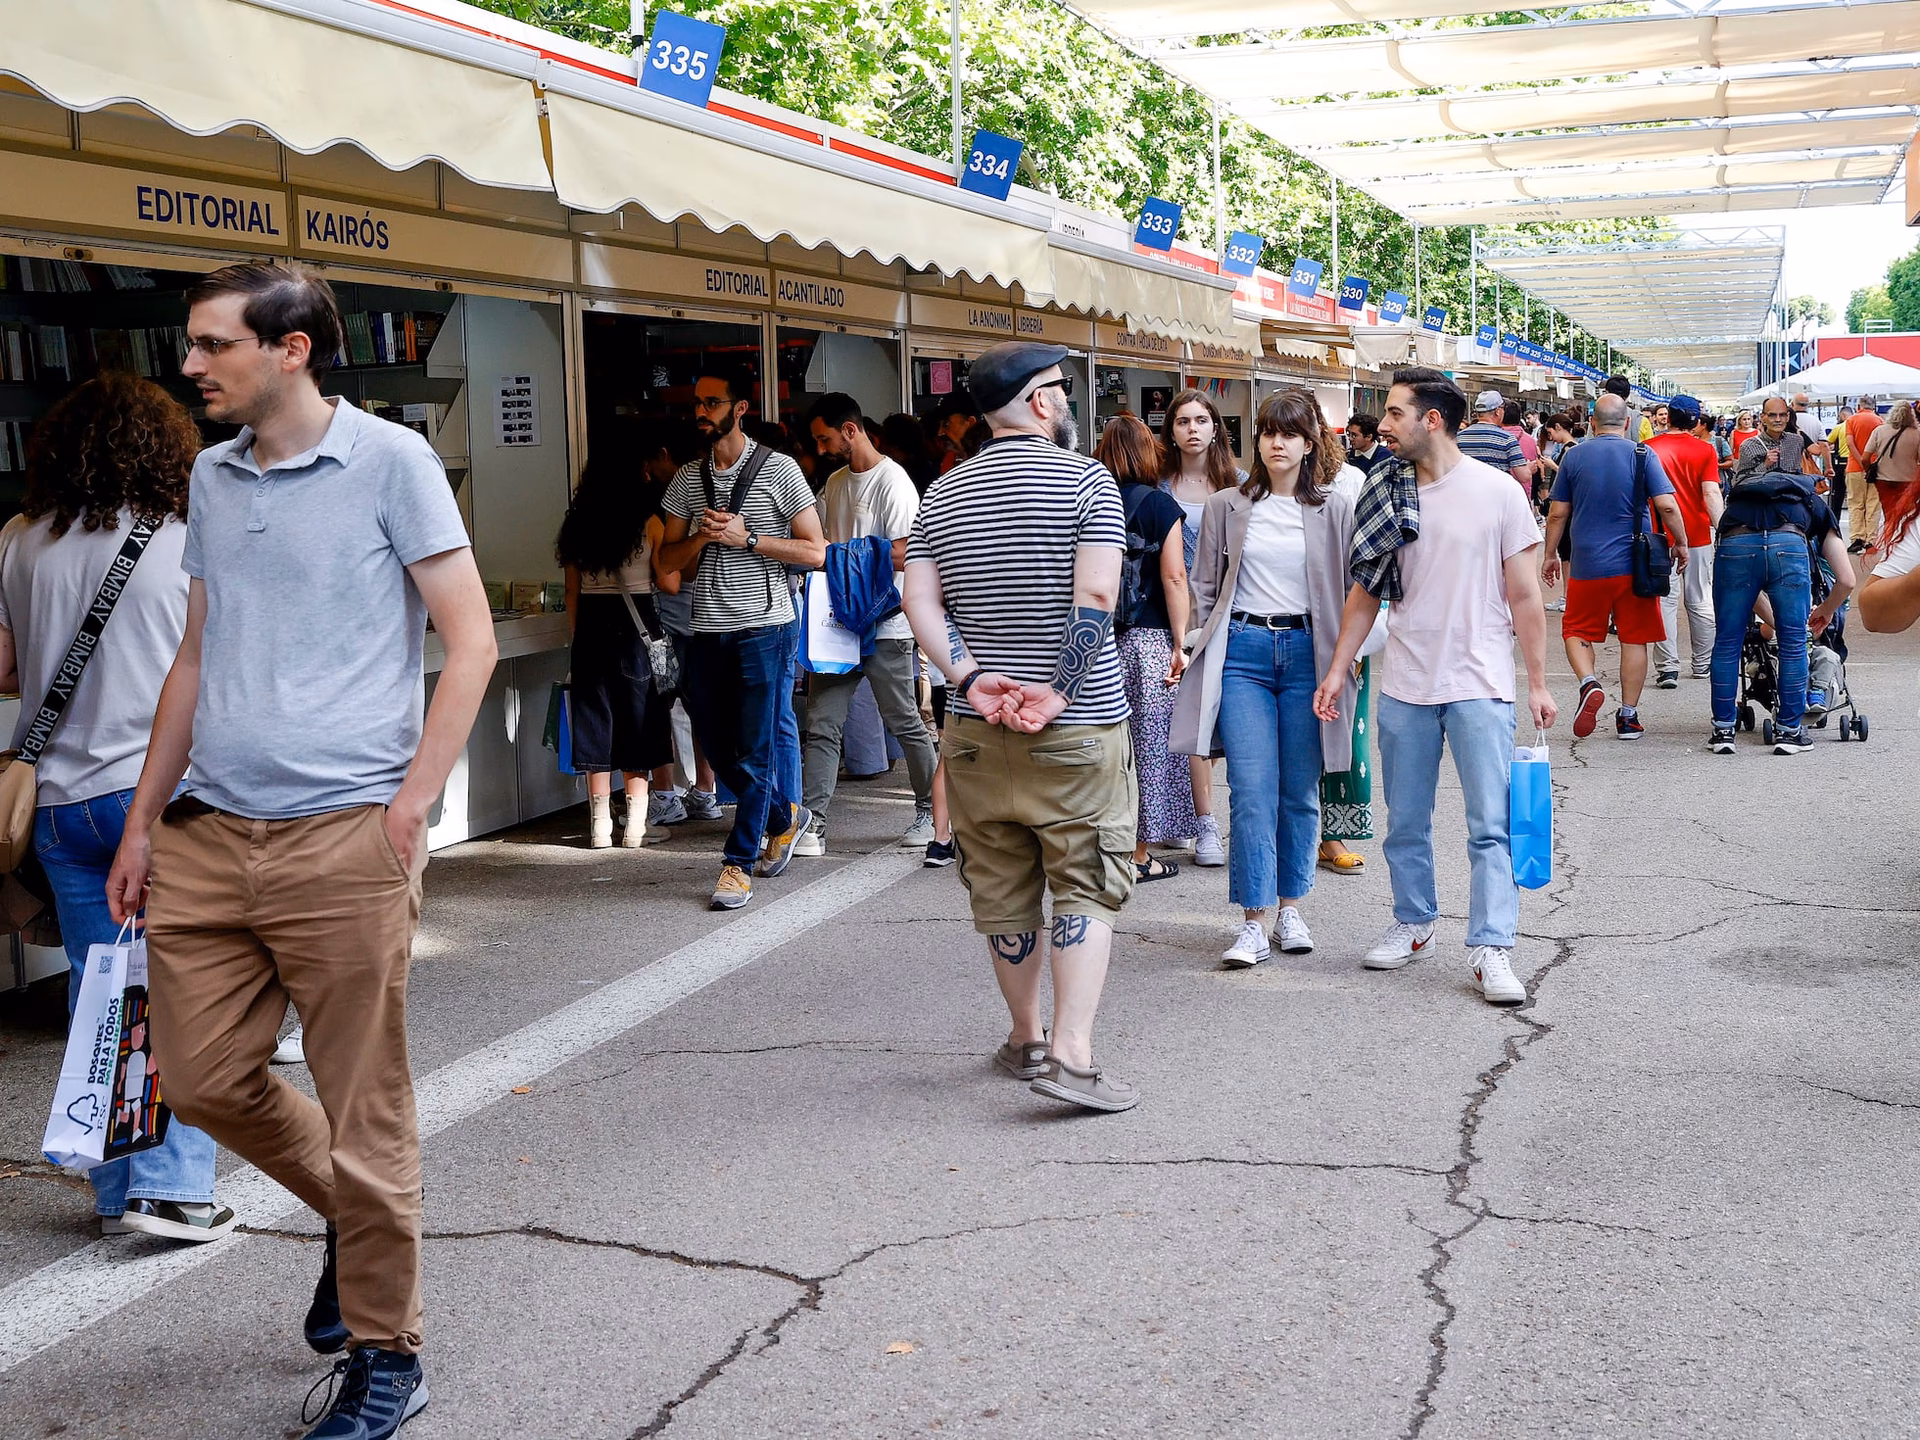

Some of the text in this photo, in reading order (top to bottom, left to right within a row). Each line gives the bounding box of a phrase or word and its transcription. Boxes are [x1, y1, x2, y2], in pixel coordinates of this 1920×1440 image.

[651, 39, 709, 81] 335
[968, 150, 1009, 180] 334
[137, 185, 390, 250] EDITORIAL KAIRÓS
[1141, 212, 1174, 235] 333
[1228, 246, 1256, 264] 332
[705, 268, 845, 308] EDITORIAL ACANTILADO
[1293, 269, 1315, 286] 331
[1342, 286, 1363, 300] 330
[1384, 301, 1402, 314] 329
[968, 307, 1043, 335] LA ANÓNIMA LIBRERÍA
[1425, 314, 1442, 327] 328
[1479, 330, 1493, 341] 327
[1503, 339, 1516, 349] 327
[91, 554, 135, 625] BIMBAY
[53, 631, 97, 700] BIMBAY
[97, 998, 119, 1085] PARA TODOS
